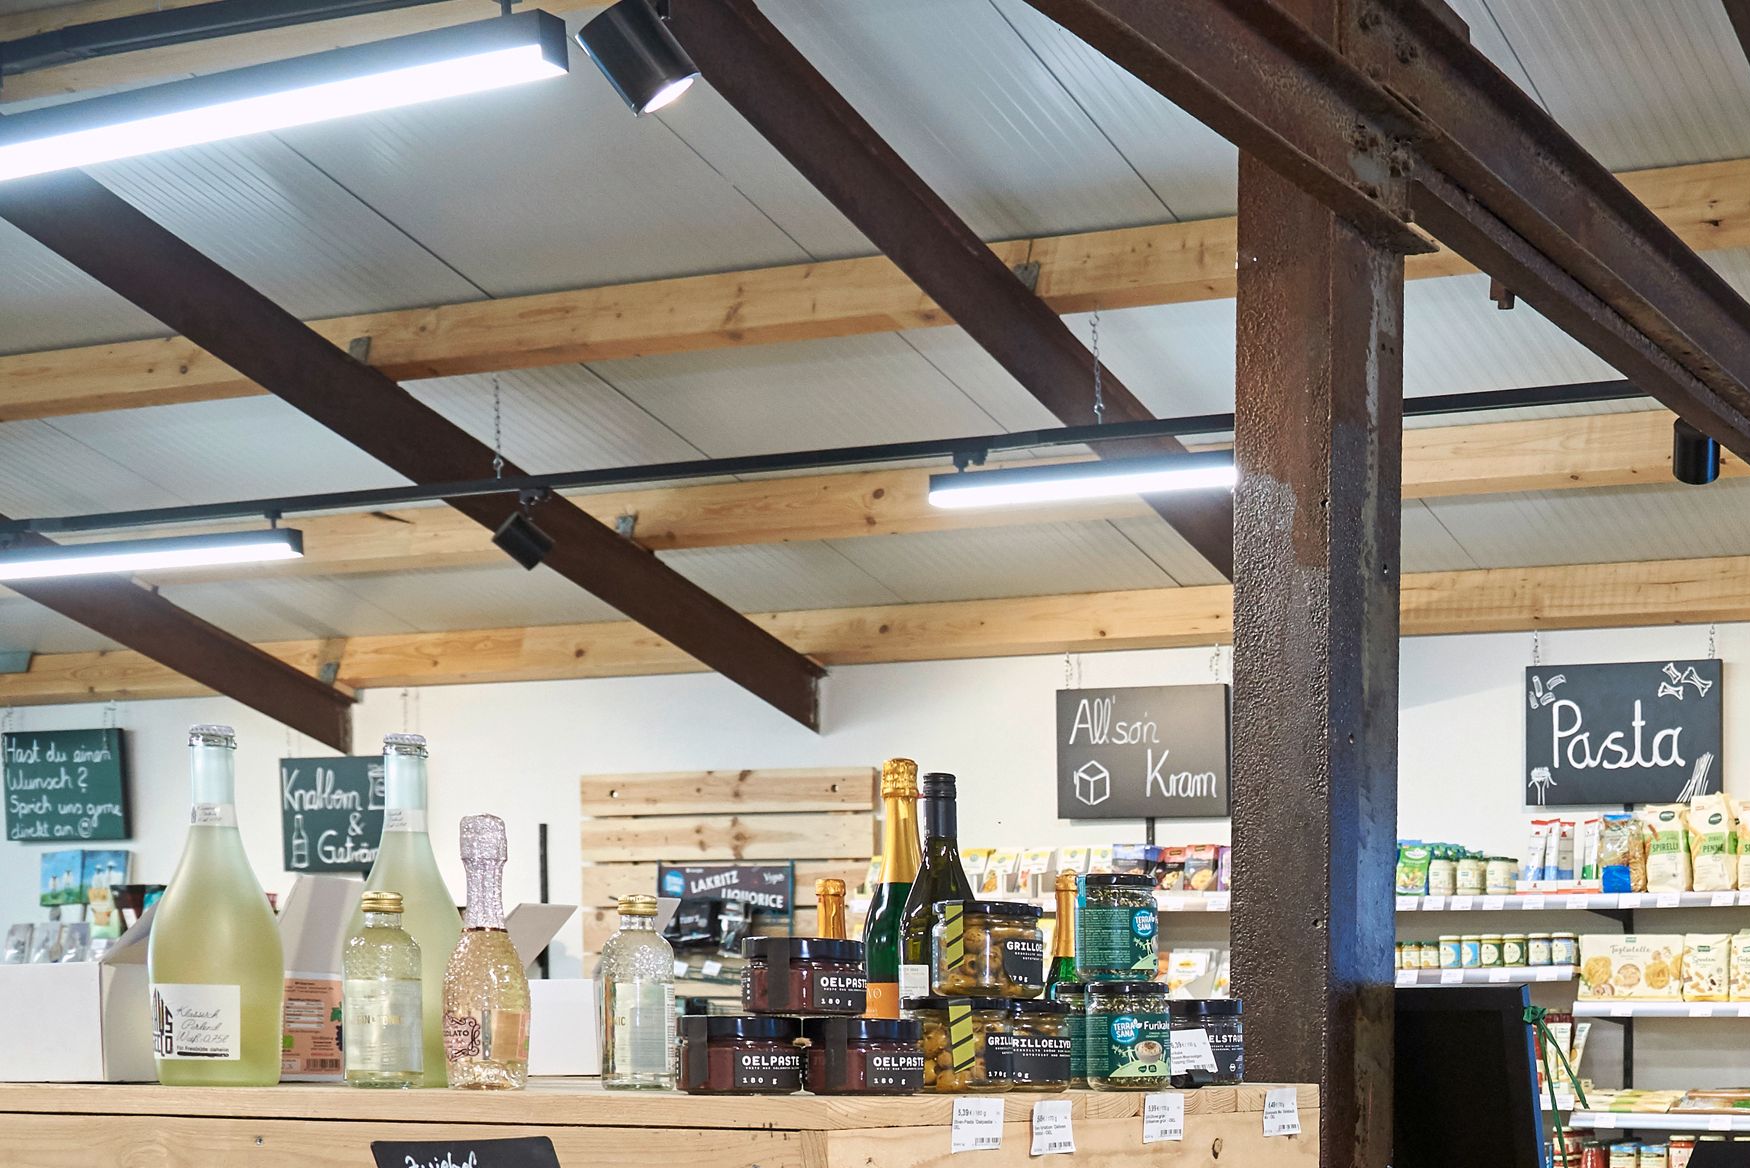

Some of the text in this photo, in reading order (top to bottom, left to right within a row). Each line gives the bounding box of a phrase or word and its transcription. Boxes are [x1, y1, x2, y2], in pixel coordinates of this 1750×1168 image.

[1553, 699, 1686, 769] Pasta
[3, 736, 112, 764] Hast du einen
[6, 766, 73, 790] Wunsch
[1146, 748, 1217, 798] Kram
[10, 795, 122, 827] Sprich uns gerne
[11, 820, 50, 839] direkt
[347, 812, 367, 836] &
[1652, 842, 1679, 851] SPIRELLI
[690, 870, 739, 894] LAKRITZ
[742, 1055, 800, 1066] OELPASTE
